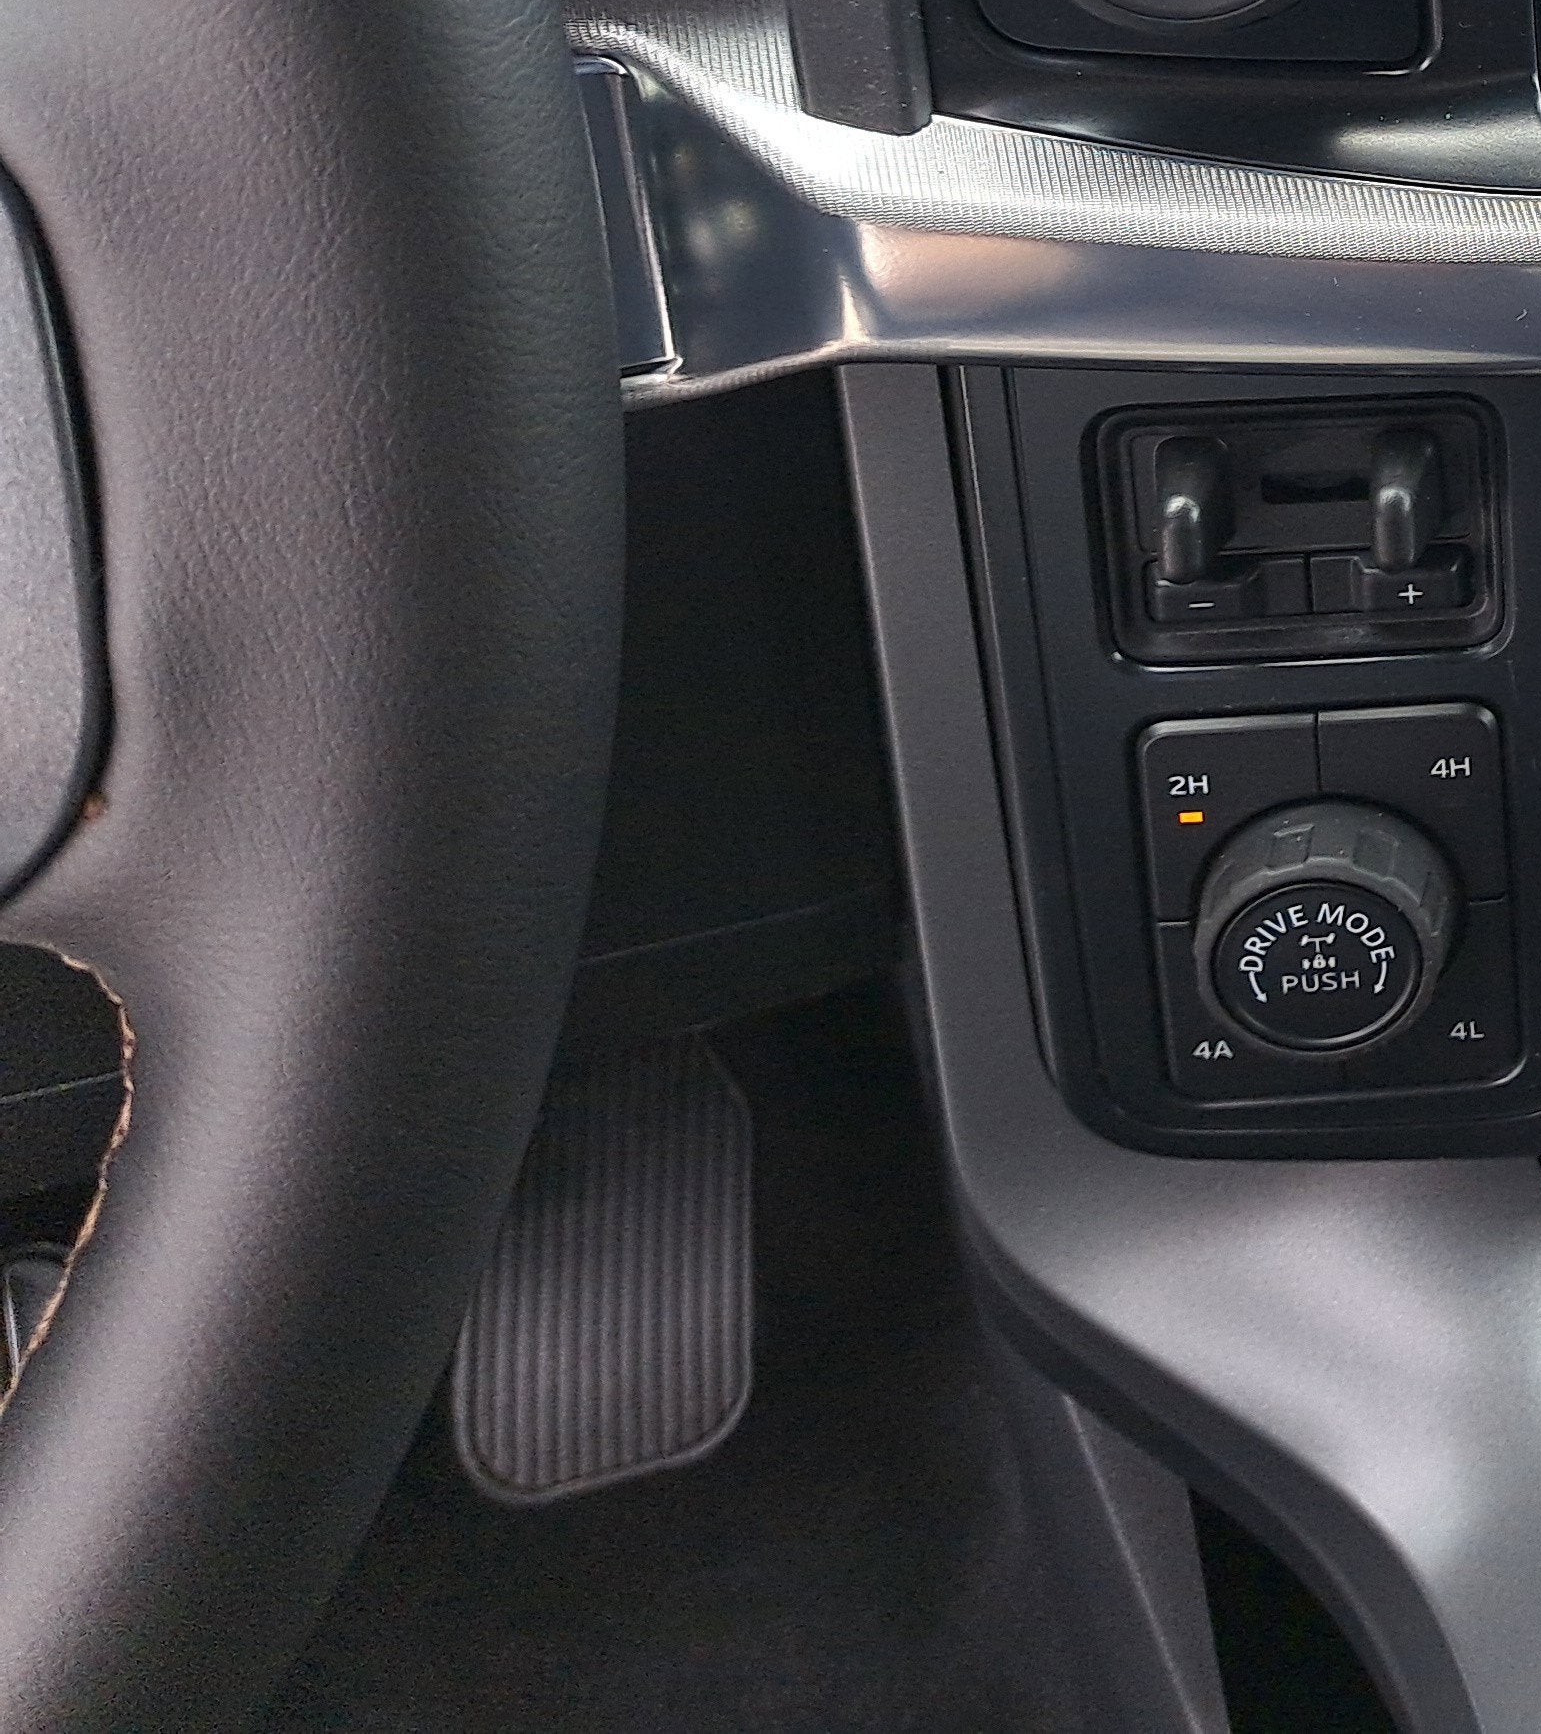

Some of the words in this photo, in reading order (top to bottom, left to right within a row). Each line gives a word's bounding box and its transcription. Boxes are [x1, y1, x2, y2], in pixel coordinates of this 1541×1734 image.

[1430, 757, 1471, 778] 4H
[1168, 775, 1210, 796] 2H
[1239, 903, 1308, 974] DRIVE
[1316, 902, 1396, 964] MODE
[1282, 970, 1361, 994] PUSH
[1449, 1022, 1486, 1041] 4L
[1192, 1040, 1235, 1060] 4A
